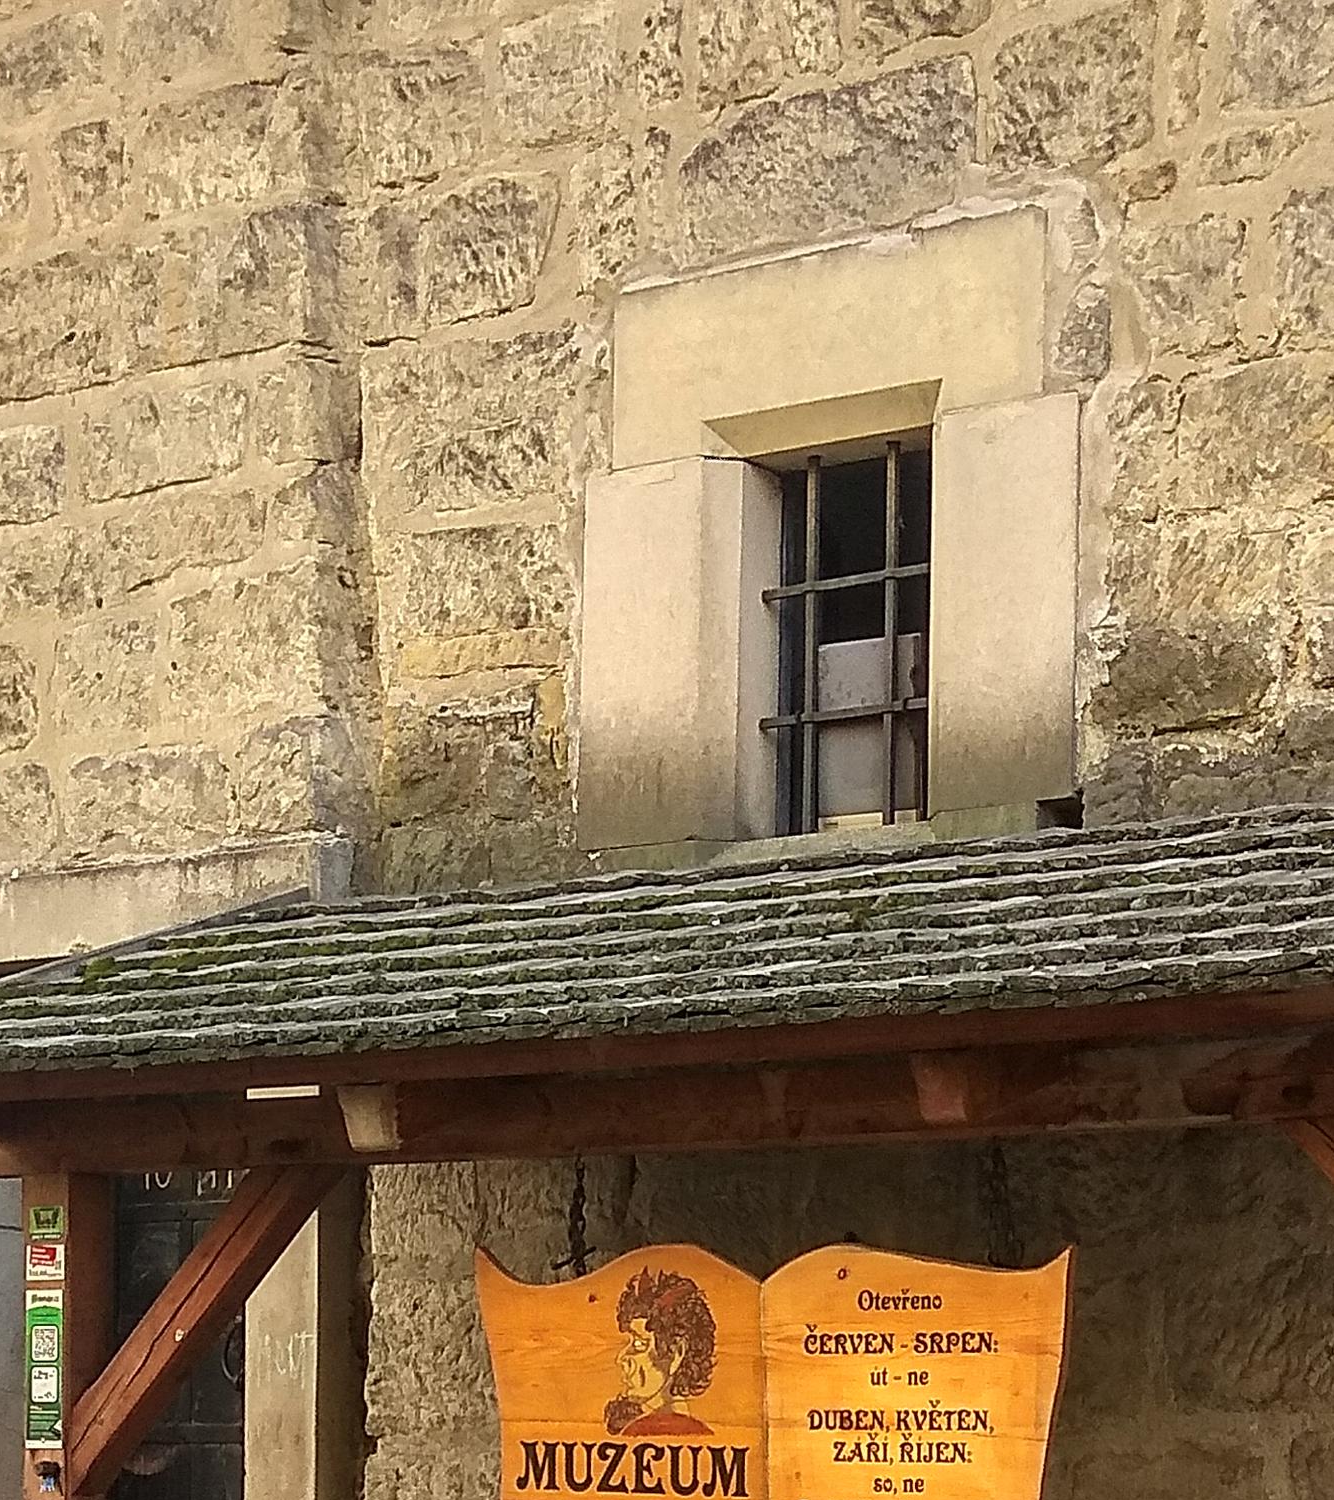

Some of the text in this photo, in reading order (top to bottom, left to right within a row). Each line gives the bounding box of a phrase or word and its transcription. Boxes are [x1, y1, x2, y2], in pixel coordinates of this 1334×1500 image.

[858, 1288, 942, 1310] Otevřeno
[804, 1324, 895, 1354] ČERVEN
[913, 1331, 998, 1354] SRPEN:
[870, 1366, 888, 1386] út
[907, 1370, 929, 1386] ne
[807, 1400, 994, 1434] DUBEN, KVĚTEN,
[833, 1432, 972, 1465] ZÁŘÍ, ŘÍJEN:
[516, 1441, 750, 1498] MUZEUM
[873, 1477, 925, 1495] so, ne
